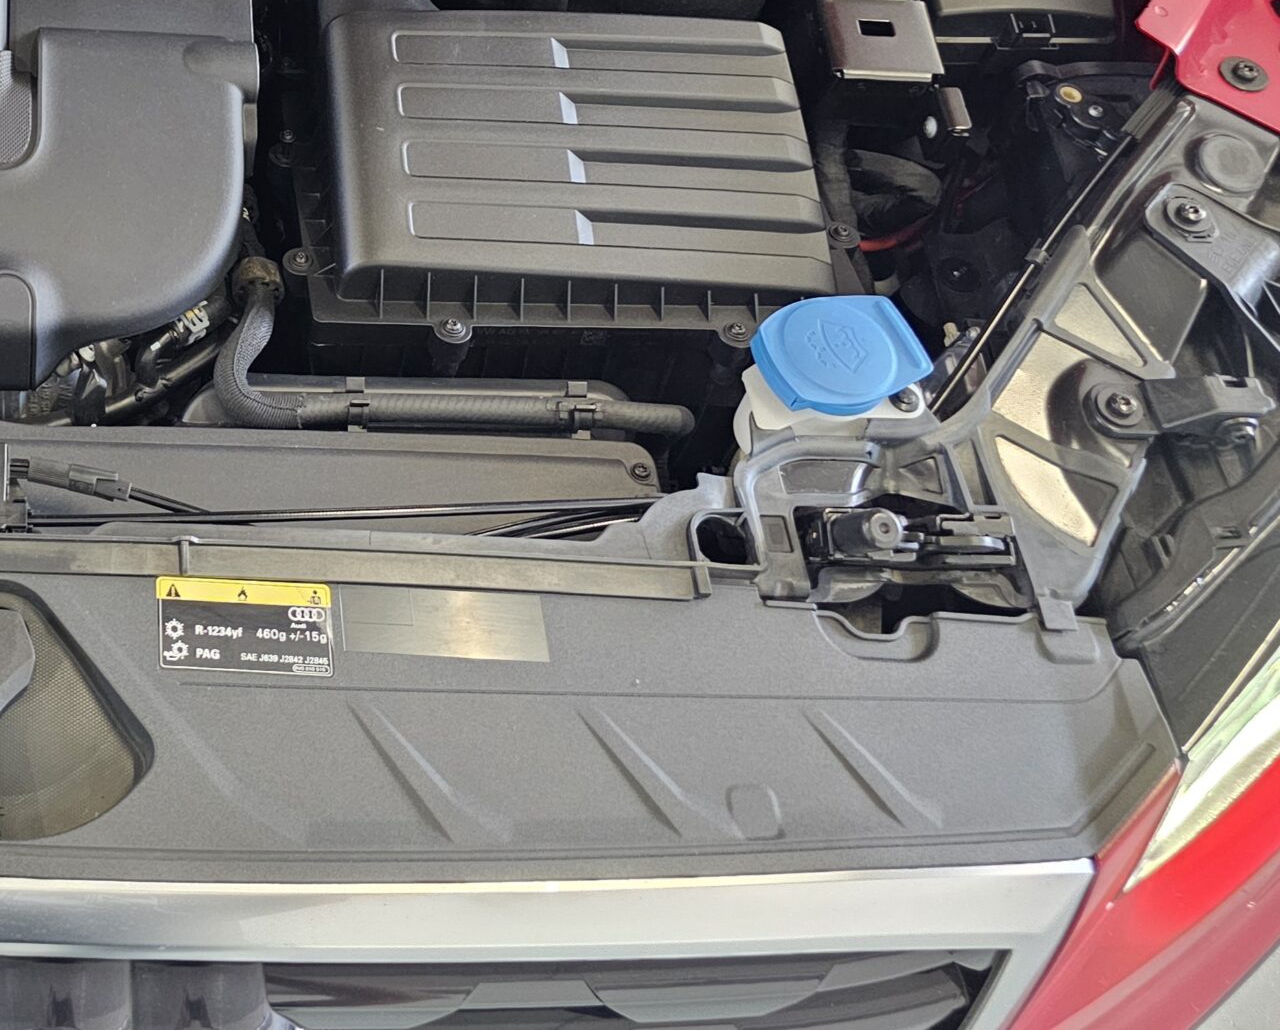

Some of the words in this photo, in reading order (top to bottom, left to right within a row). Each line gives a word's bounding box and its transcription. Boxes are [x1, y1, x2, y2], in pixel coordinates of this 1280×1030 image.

[195, 624, 243, 639] R-1234yf
[256, 628, 286, 642] 460g
[196, 648, 220, 660] PAG
[240, 653, 258, 662] SAE
